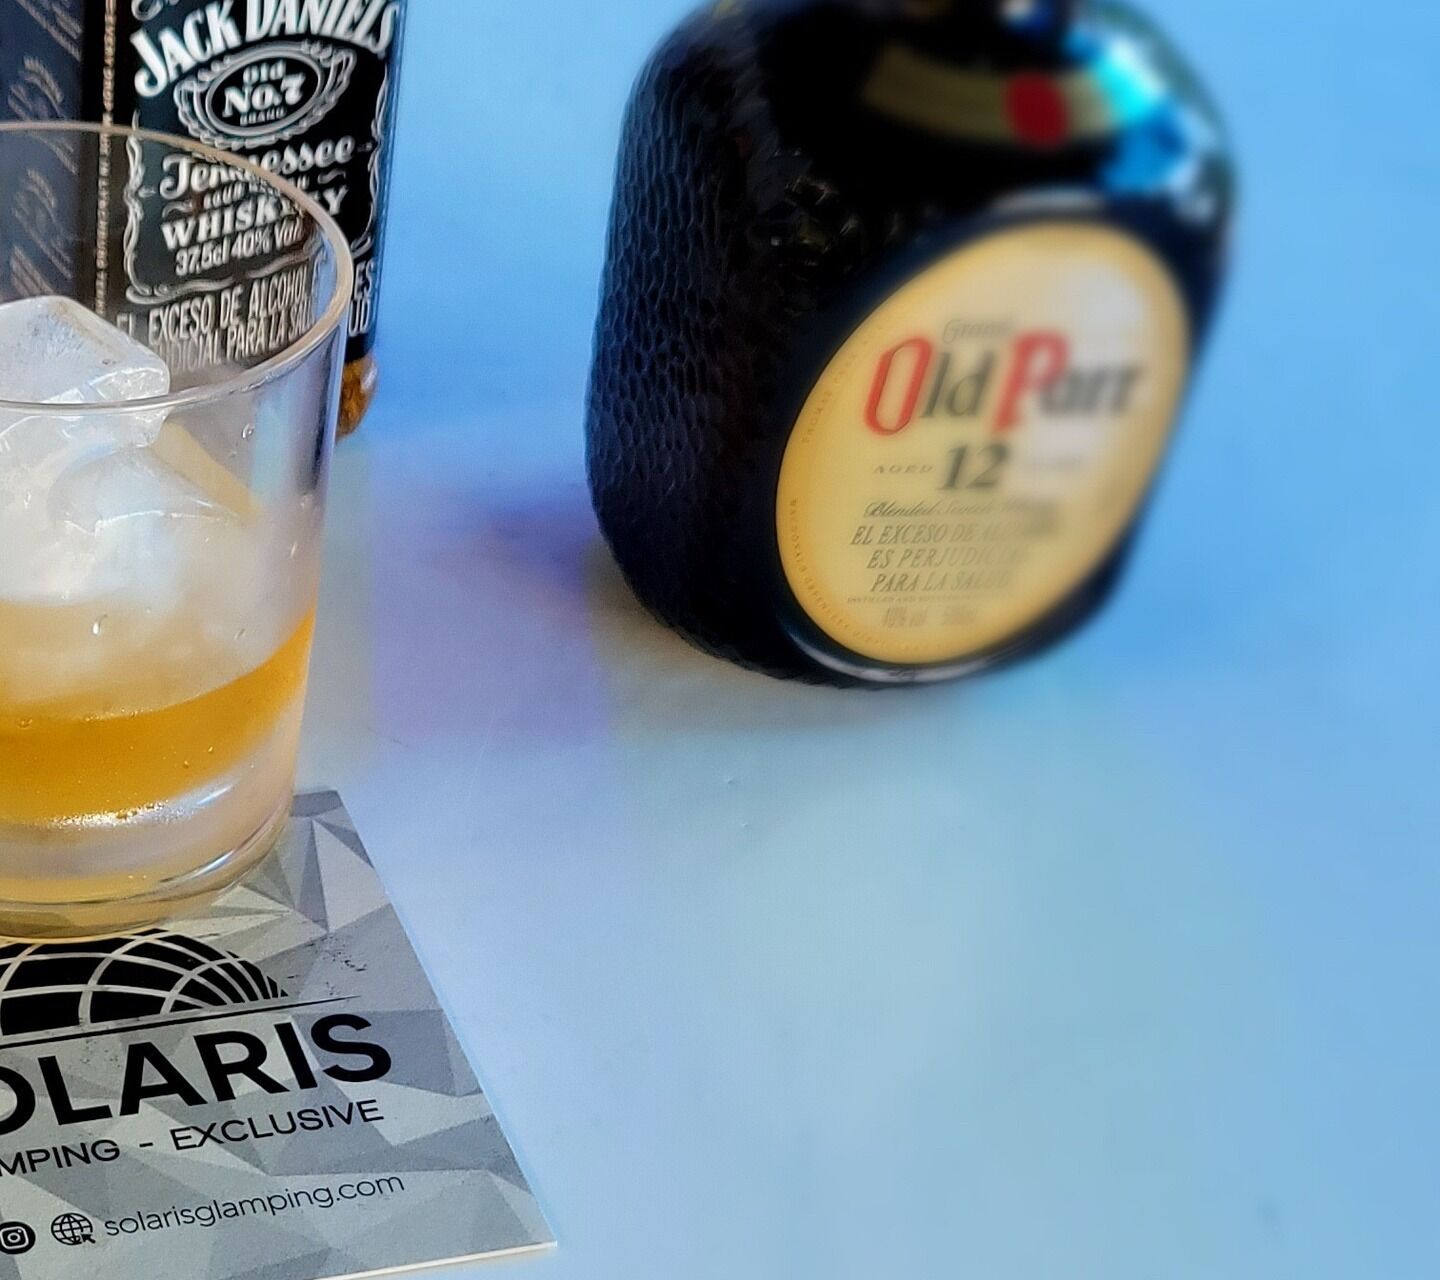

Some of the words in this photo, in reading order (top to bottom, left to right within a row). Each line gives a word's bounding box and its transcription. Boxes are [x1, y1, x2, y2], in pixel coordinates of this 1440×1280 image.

[239, 107, 287, 127] BRAND
[231, 227, 273, 260] 40%
[148, 295, 216, 346] EXCESO
[220, 284, 244, 329] DE
[248, 264, 311, 317] ALCOHOL
[353, 260, 375, 301] ES
[226, 316, 266, 361] PARA
[268, 307, 287, 349] LA
[863, 335, 998, 438] Old
[872, 464, 934, 475] AGED
[936, 443, 1008, 492] 12
[862, 500, 942, 518] Blended
[850, 525, 875, 546] EL
[877, 523, 948, 545] EXCESO
[949, 523, 979, 543] DE
[866, 548, 894, 569] ES
[870, 573, 921, 593] PARA
[921, 571, 950, 591] LA
[174, 1099, 385, 1151] EXCLUSIVE
[104, 1172, 406, 1238] solarisglamping.com
